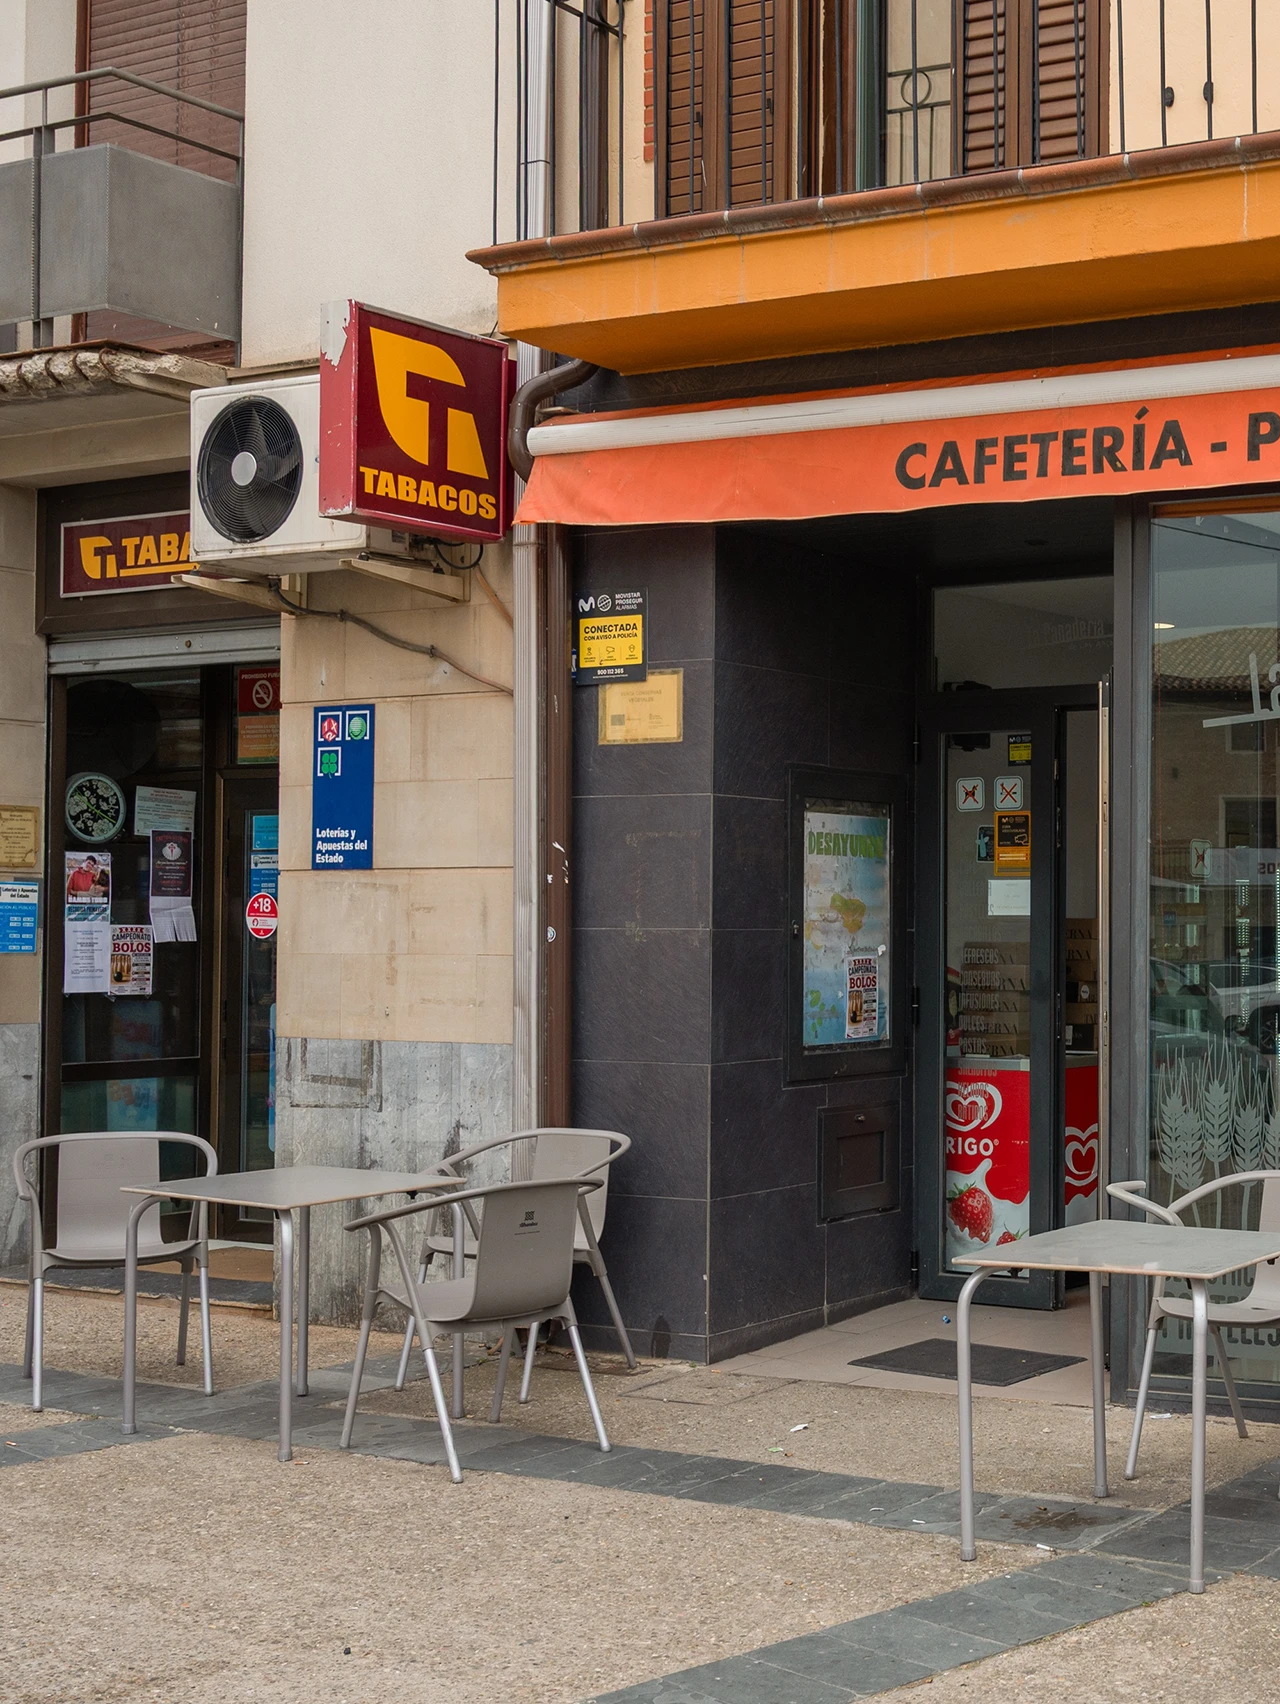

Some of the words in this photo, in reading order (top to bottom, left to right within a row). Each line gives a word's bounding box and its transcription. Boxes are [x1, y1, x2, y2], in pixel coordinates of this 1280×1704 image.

[895, 407, 1192, 491] CAFETERÍA
[359, 466, 497, 520] TABACOS
[584, 623, 638, 635] CONECTADA
[316, 827, 349, 838] Loterías
[350, 829, 356, 842] y
[316, 842, 353, 853] Apuestas
[355, 840, 368, 850] del
[316, 853, 344, 864] Estado
[253, 898, 271, 913] +18
[112, 933, 151, 942] CAMPEONATO
[112, 942, 151, 953] BOLOS
[849, 976, 877, 989] BOLOS
[946, 1137, 994, 1156] RIGO
